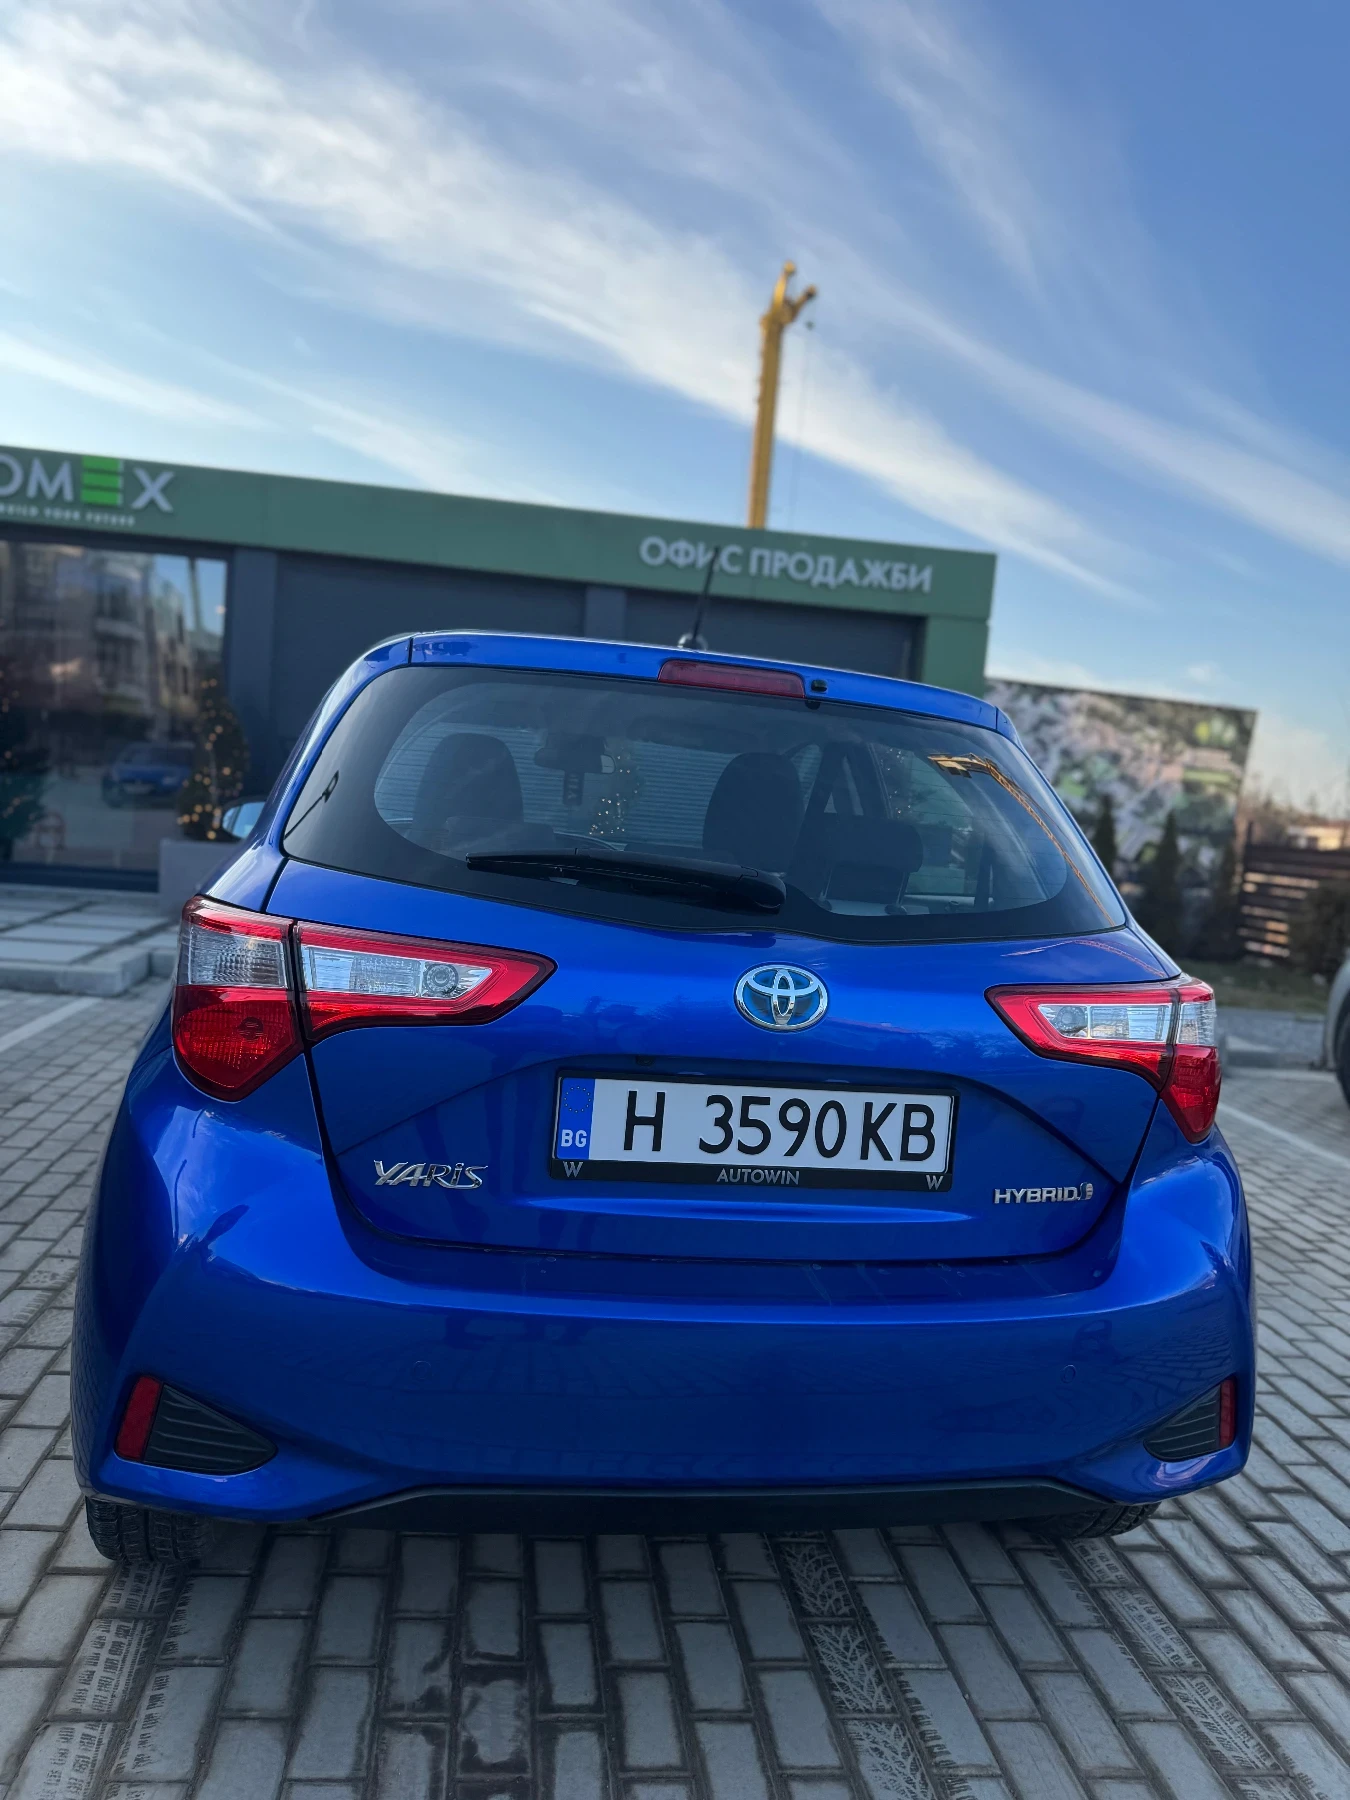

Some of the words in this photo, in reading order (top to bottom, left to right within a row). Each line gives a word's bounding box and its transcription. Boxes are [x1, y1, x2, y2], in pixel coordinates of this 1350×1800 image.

[639, 536, 744, 574] ОФИС
[749, 547, 933, 593] ПРОДАЖБИ
[560, 1129, 588, 1148] BG
[716, 1167, 800, 1186] AUTOWIN
[993, 1186, 1079, 1204] HYBRID
